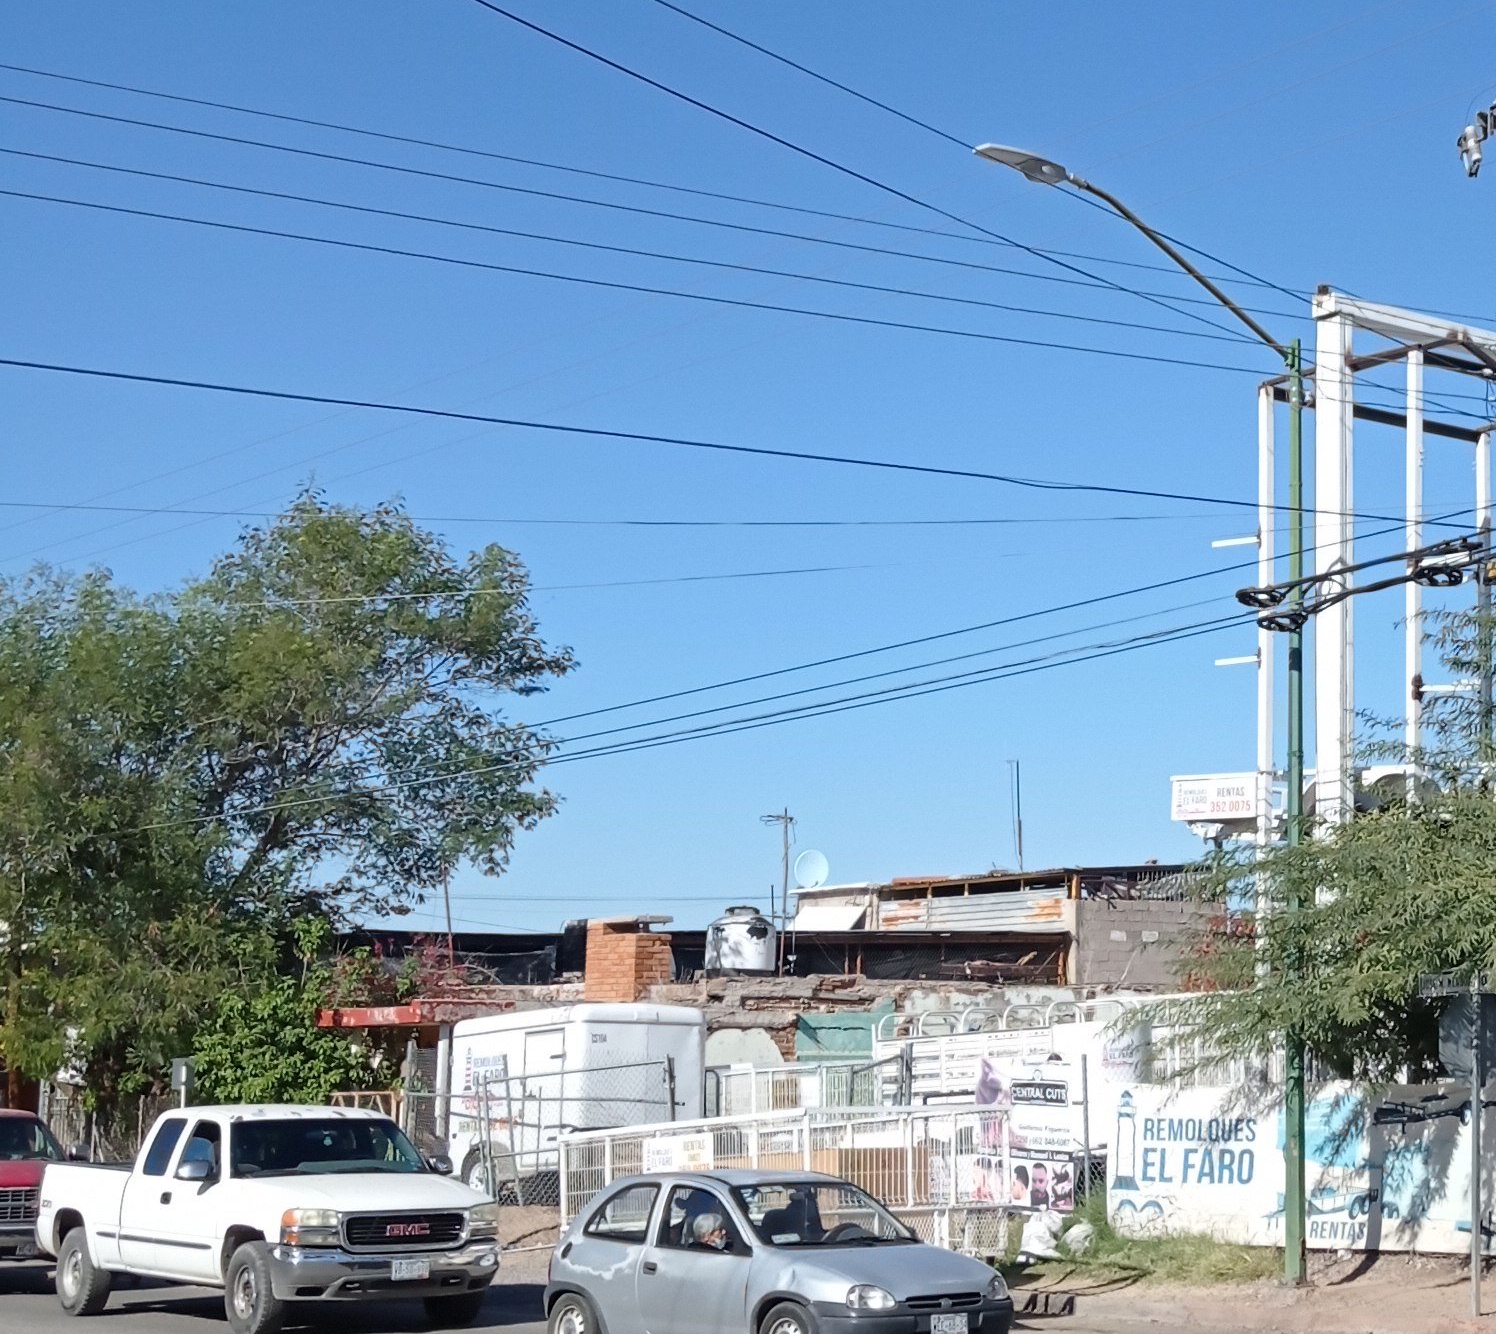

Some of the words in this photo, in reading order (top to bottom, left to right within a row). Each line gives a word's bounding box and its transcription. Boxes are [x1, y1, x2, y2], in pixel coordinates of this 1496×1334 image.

[1216, 787, 1245, 797] RENTAS
[1210, 800, 1227, 813] 352
[1229, 800, 1251, 812] 0075
[1012, 1087, 1045, 1099] CENTRAL
[1046, 1088, 1066, 1100] CUTS
[1143, 1118, 1257, 1142] REMOLQUES
[1142, 1147, 1173, 1182] EL
[1182, 1147, 1255, 1184] FARO
[386, 1223, 430, 1236] GMC
[1309, 1220, 1367, 1240] RENTAS
